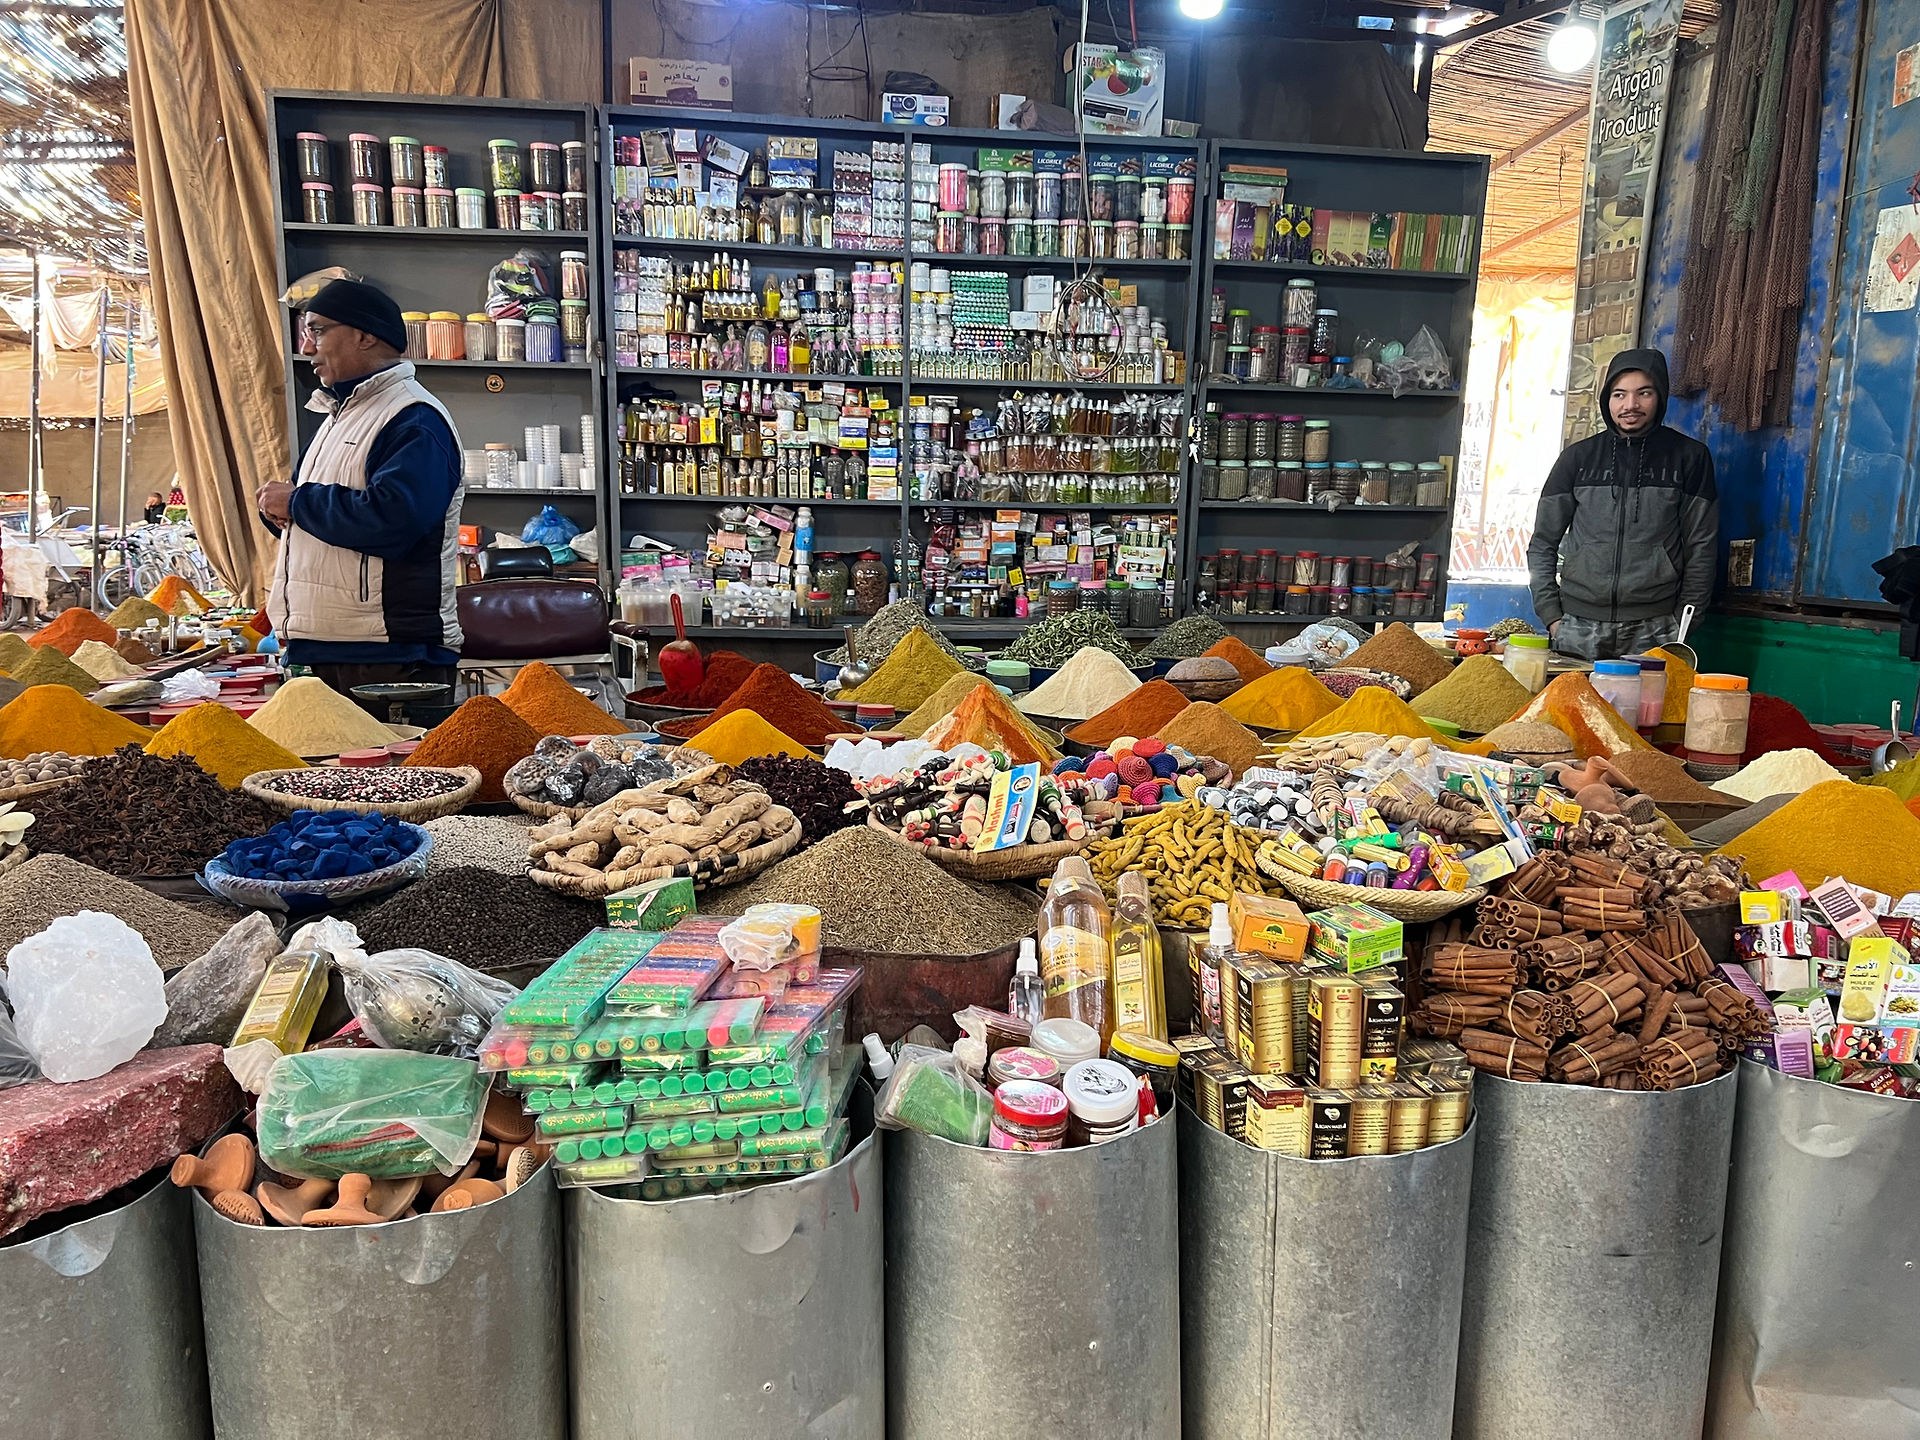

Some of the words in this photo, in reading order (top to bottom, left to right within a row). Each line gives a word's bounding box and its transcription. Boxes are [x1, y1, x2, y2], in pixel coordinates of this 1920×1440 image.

[1609, 62, 1664, 101] Argan
[1598, 101, 1663, 146] Produit
[985, 793, 1005, 834] Hashmi
